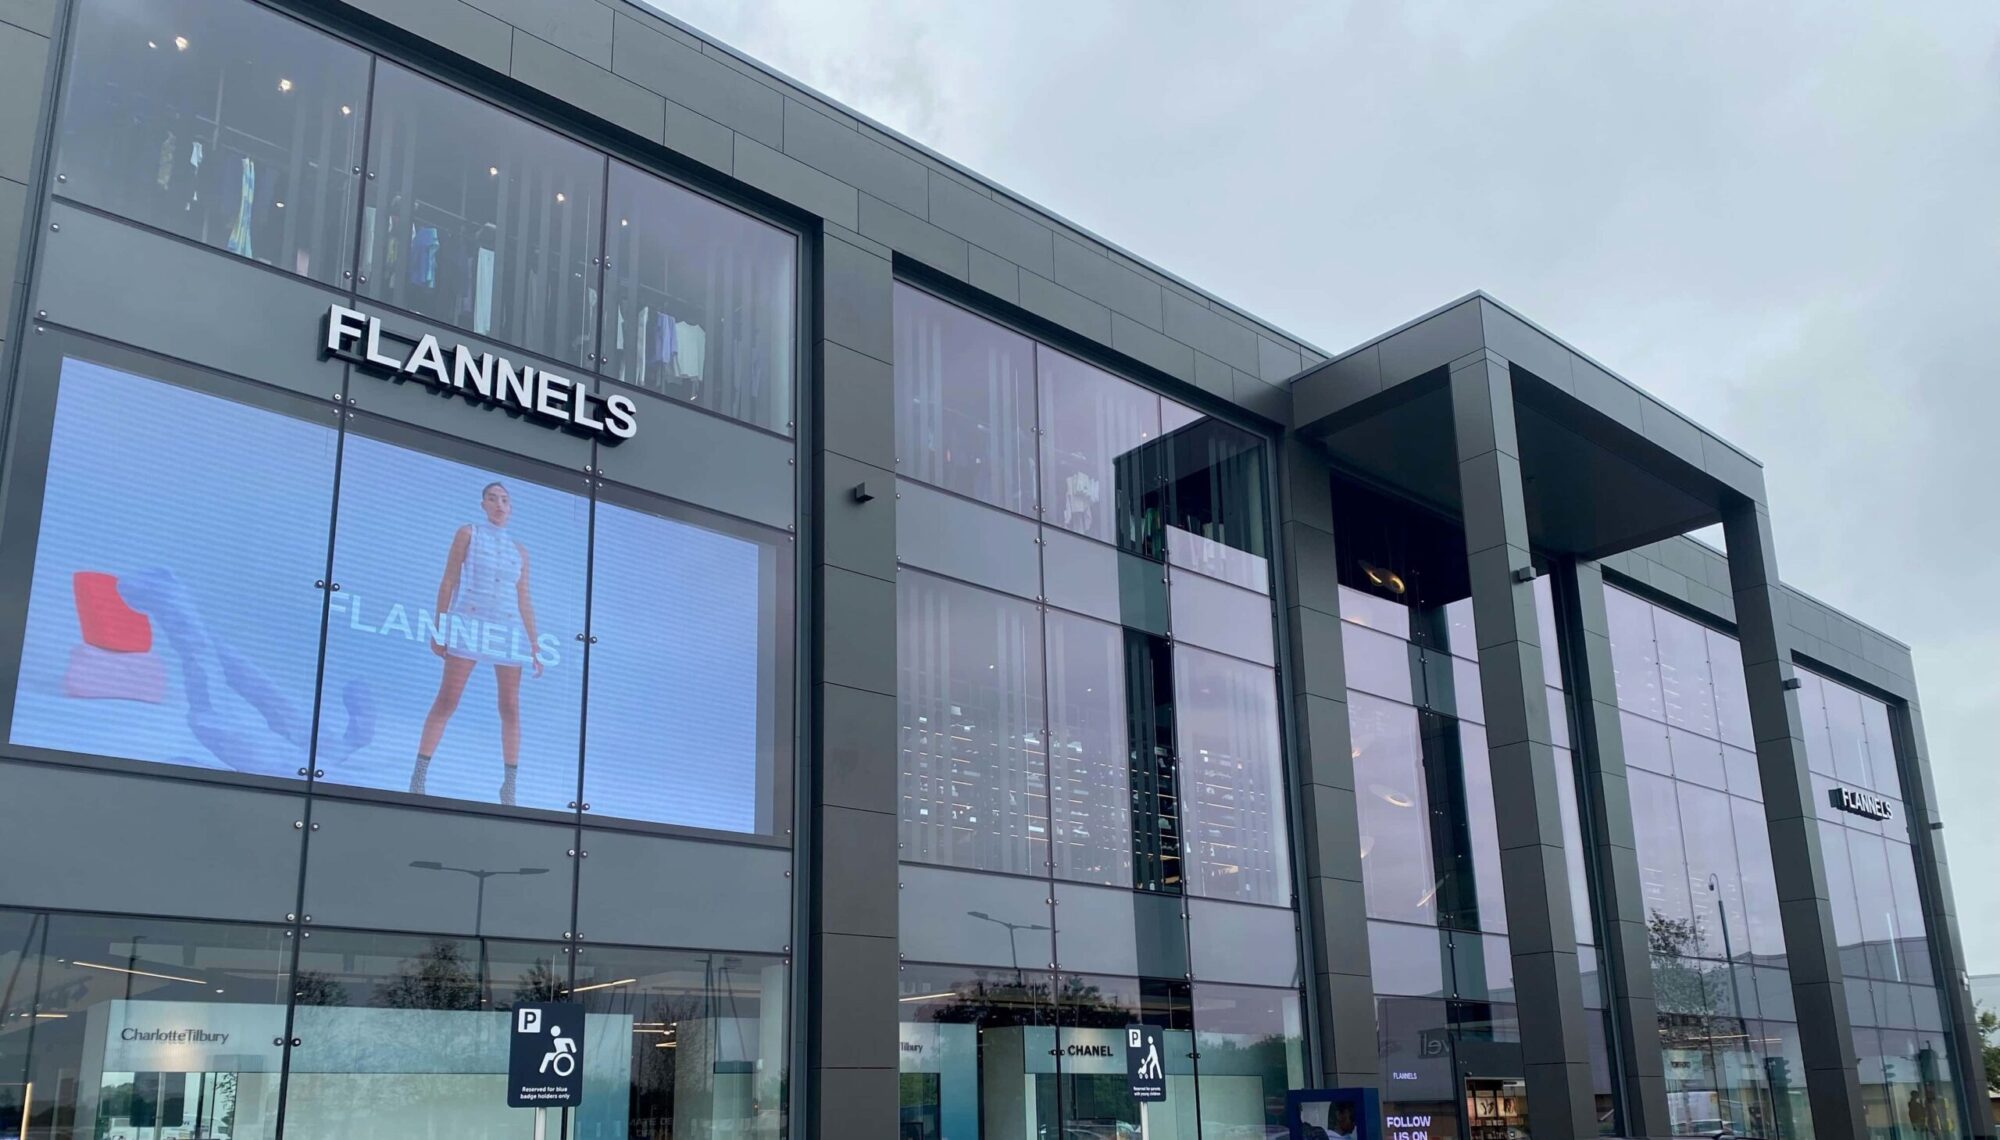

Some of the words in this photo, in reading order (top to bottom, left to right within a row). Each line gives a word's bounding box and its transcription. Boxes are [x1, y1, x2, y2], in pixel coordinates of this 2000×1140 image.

[327, 303, 637, 439] FLANNELS
[321, 591, 561, 667] FLANNELS
[1841, 787, 1893, 819] FLANNELS
[524, 1012, 536, 1030] P
[1132, 1031, 1139, 1045] P
[1067, 1044, 1114, 1057] CHANEL
[1393, 1072, 1418, 1080] FLANNELS
[1386, 1116, 1431, 1128] FOLLOW
[1393, 1131, 1410, 1140] US
[1412, 1131, 1428, 1140] ON
